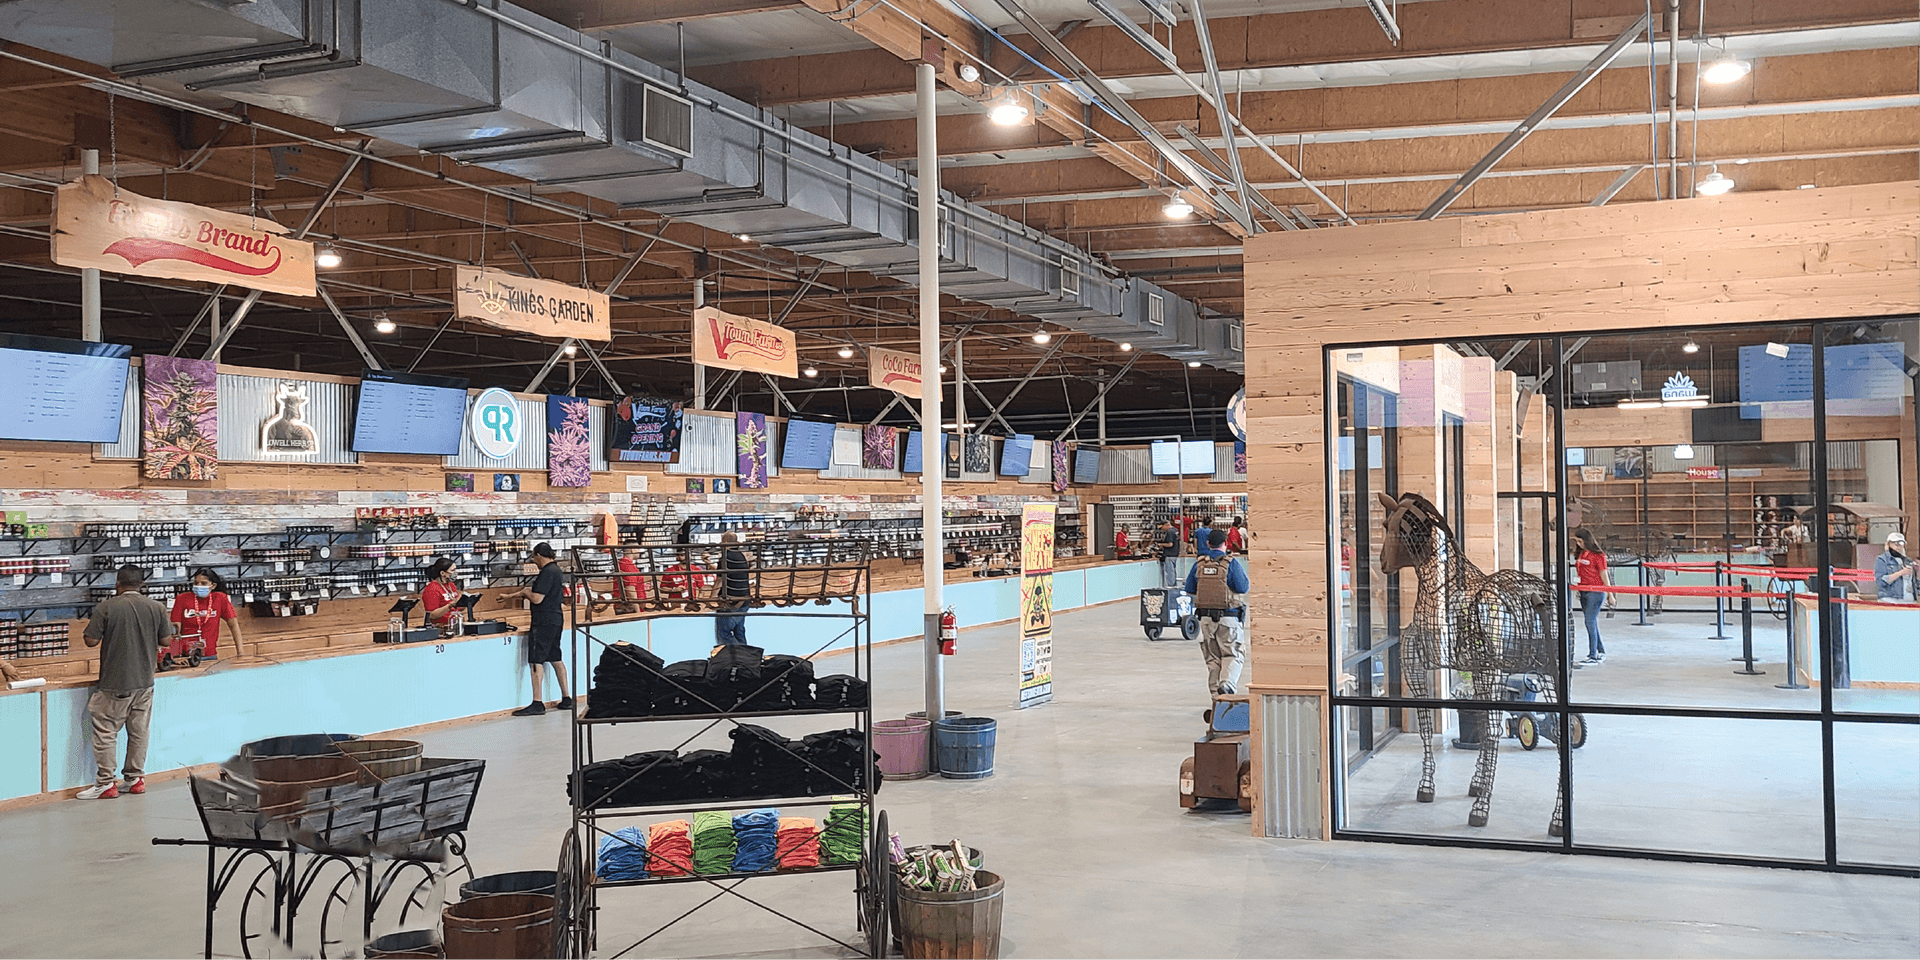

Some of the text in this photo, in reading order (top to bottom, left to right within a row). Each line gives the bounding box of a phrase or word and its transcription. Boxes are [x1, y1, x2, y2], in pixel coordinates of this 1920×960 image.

[197, 221, 271, 256] Brand
[509, 290, 594, 323] KINGS GARDEN
[882, 354, 902, 372] CoCo
[635, 423, 661, 432] GRAND
[631, 433, 663, 444] OPENING
[1689, 468, 1718, 476] House
[503, 637, 512, 645] 19
[435, 644, 445, 653] 20
